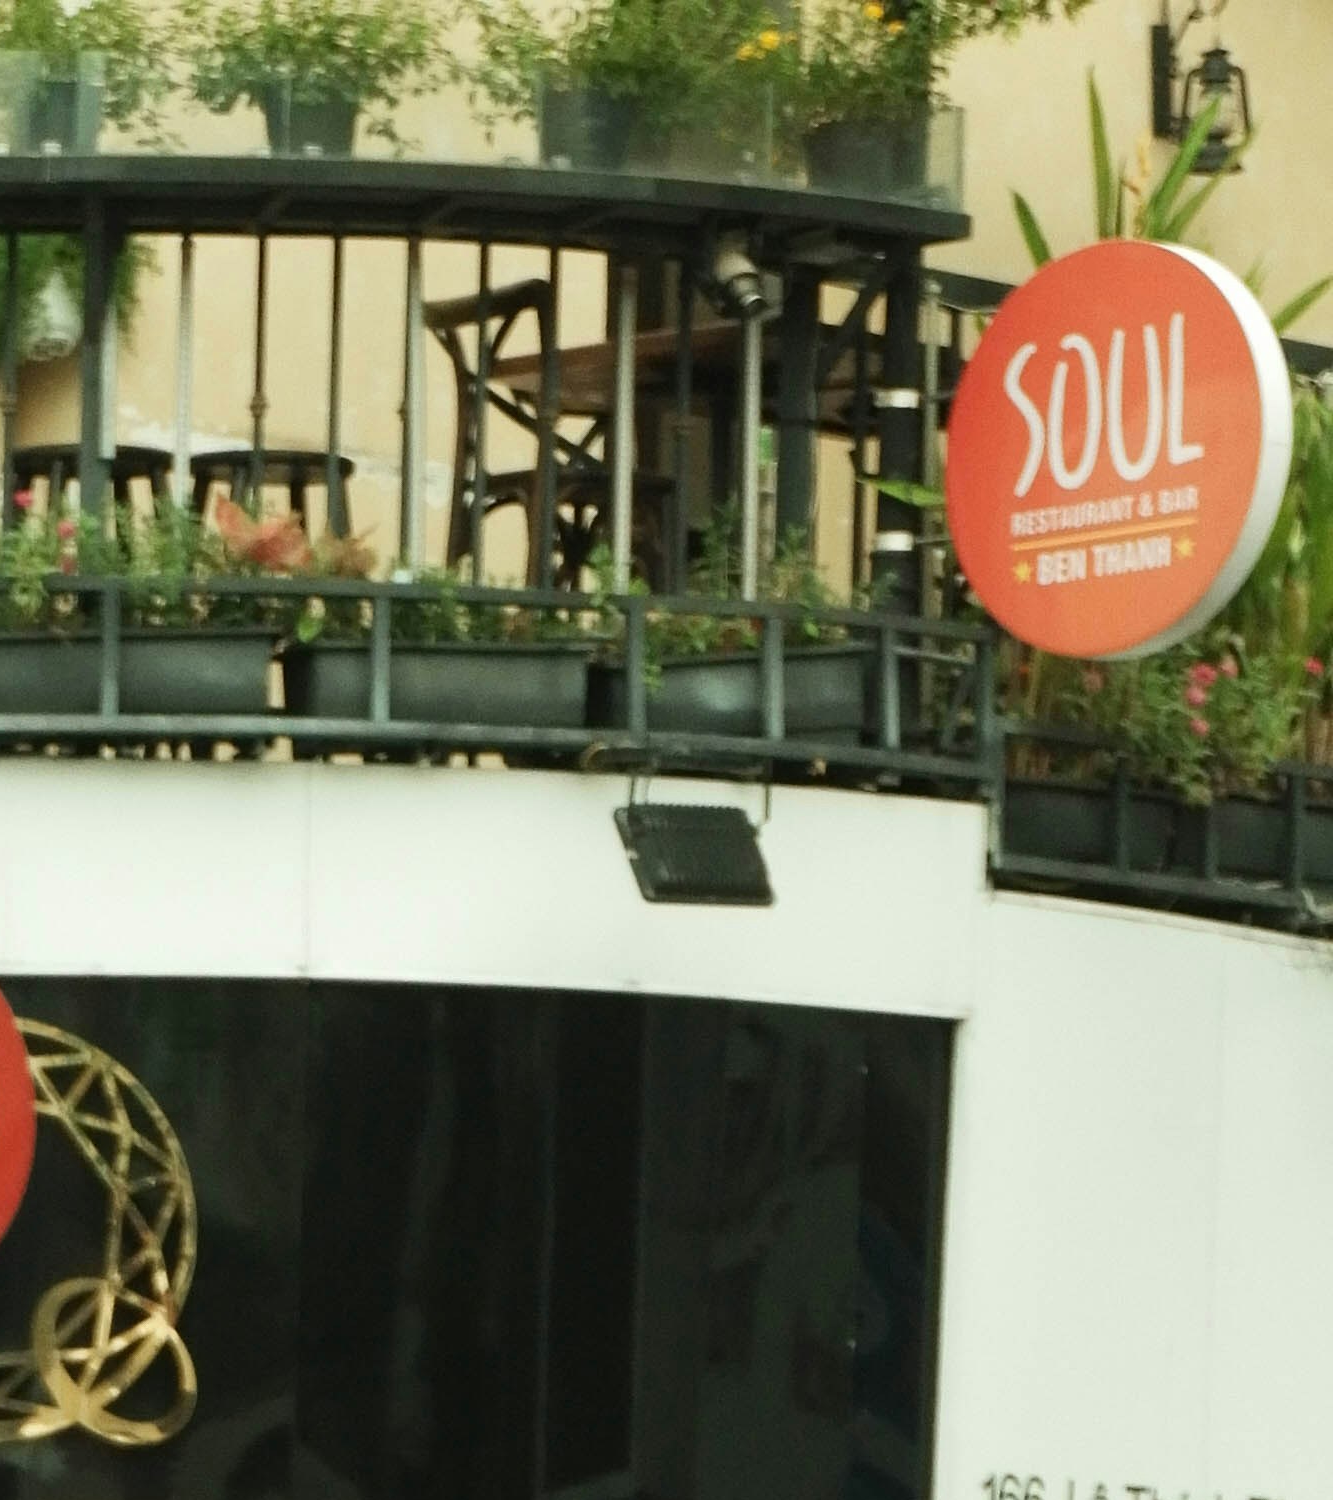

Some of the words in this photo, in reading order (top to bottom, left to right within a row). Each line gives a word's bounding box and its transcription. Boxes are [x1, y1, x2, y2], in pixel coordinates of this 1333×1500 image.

[1003, 312, 1204, 498] SOUL
[1010, 496, 1134, 538] RESTAURANT
[1137, 491, 1154, 517] &
[1158, 486, 1199, 514] BAR
[1036, 550, 1087, 586] BEN
[1091, 535, 1172, 577] THANH
